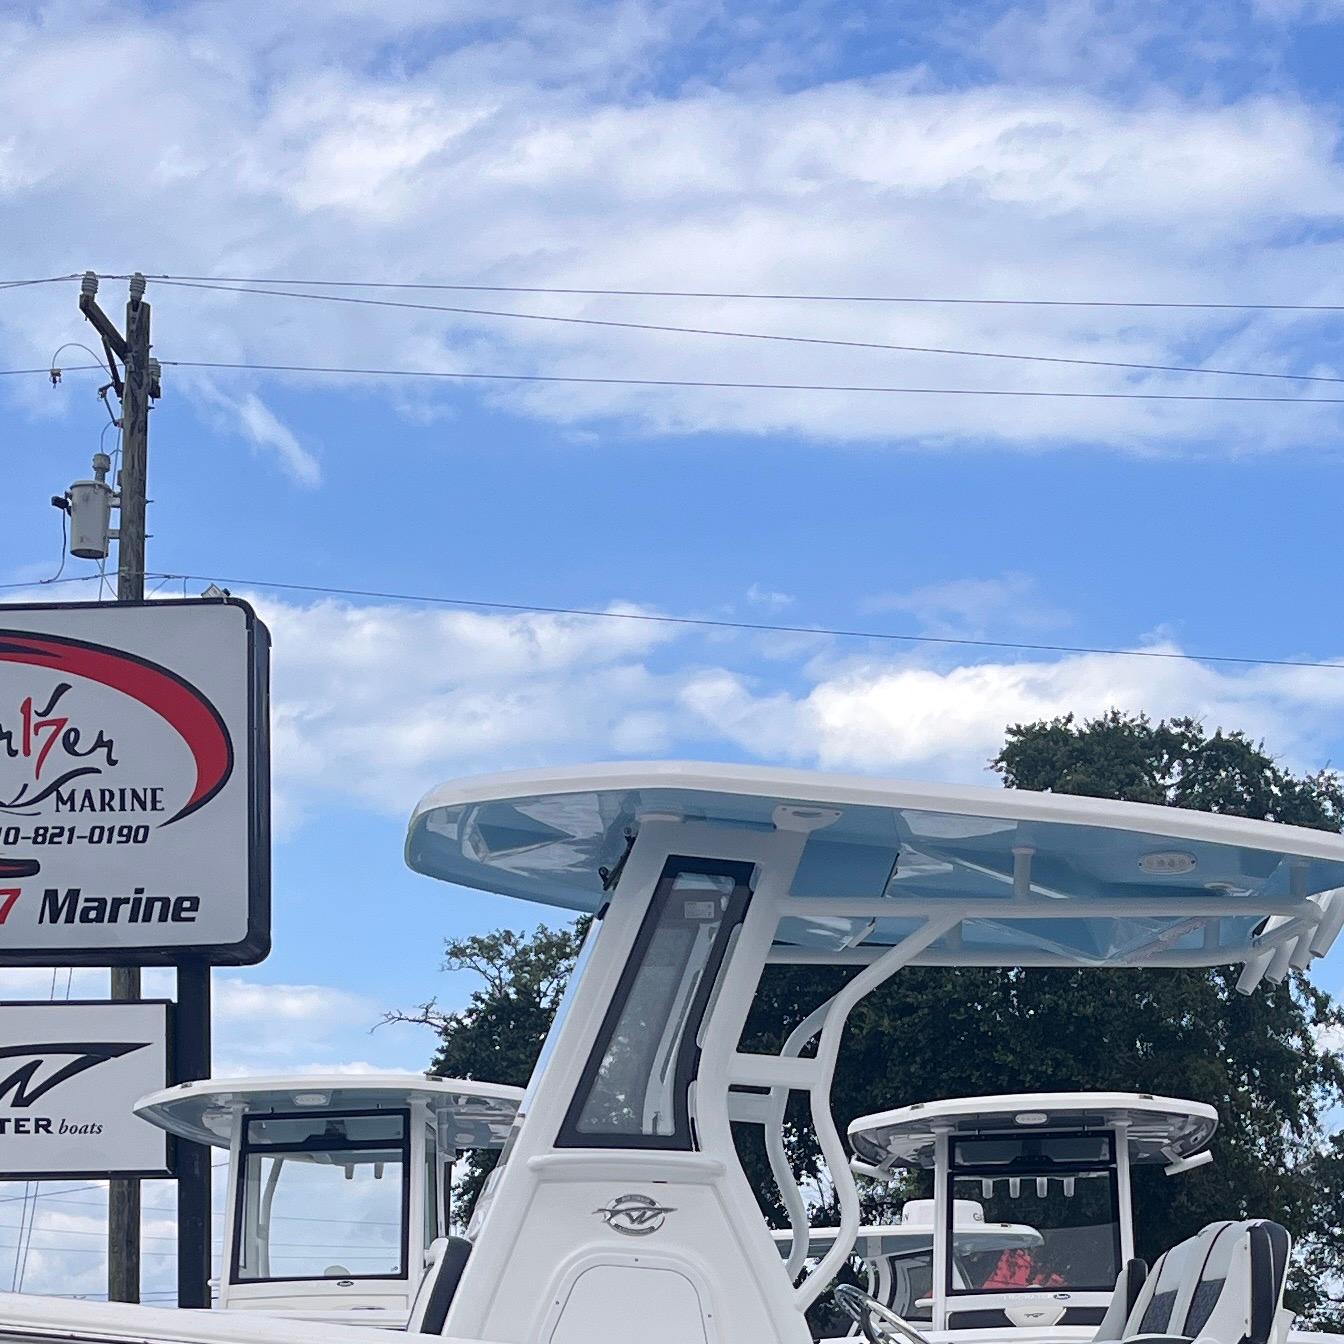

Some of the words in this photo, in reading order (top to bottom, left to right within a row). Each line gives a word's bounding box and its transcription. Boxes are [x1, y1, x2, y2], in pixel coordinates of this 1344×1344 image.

[54, 787, 165, 813] MARINE
[38, 887, 201, 924] Marine
[58, 1118, 104, 1136] boats
